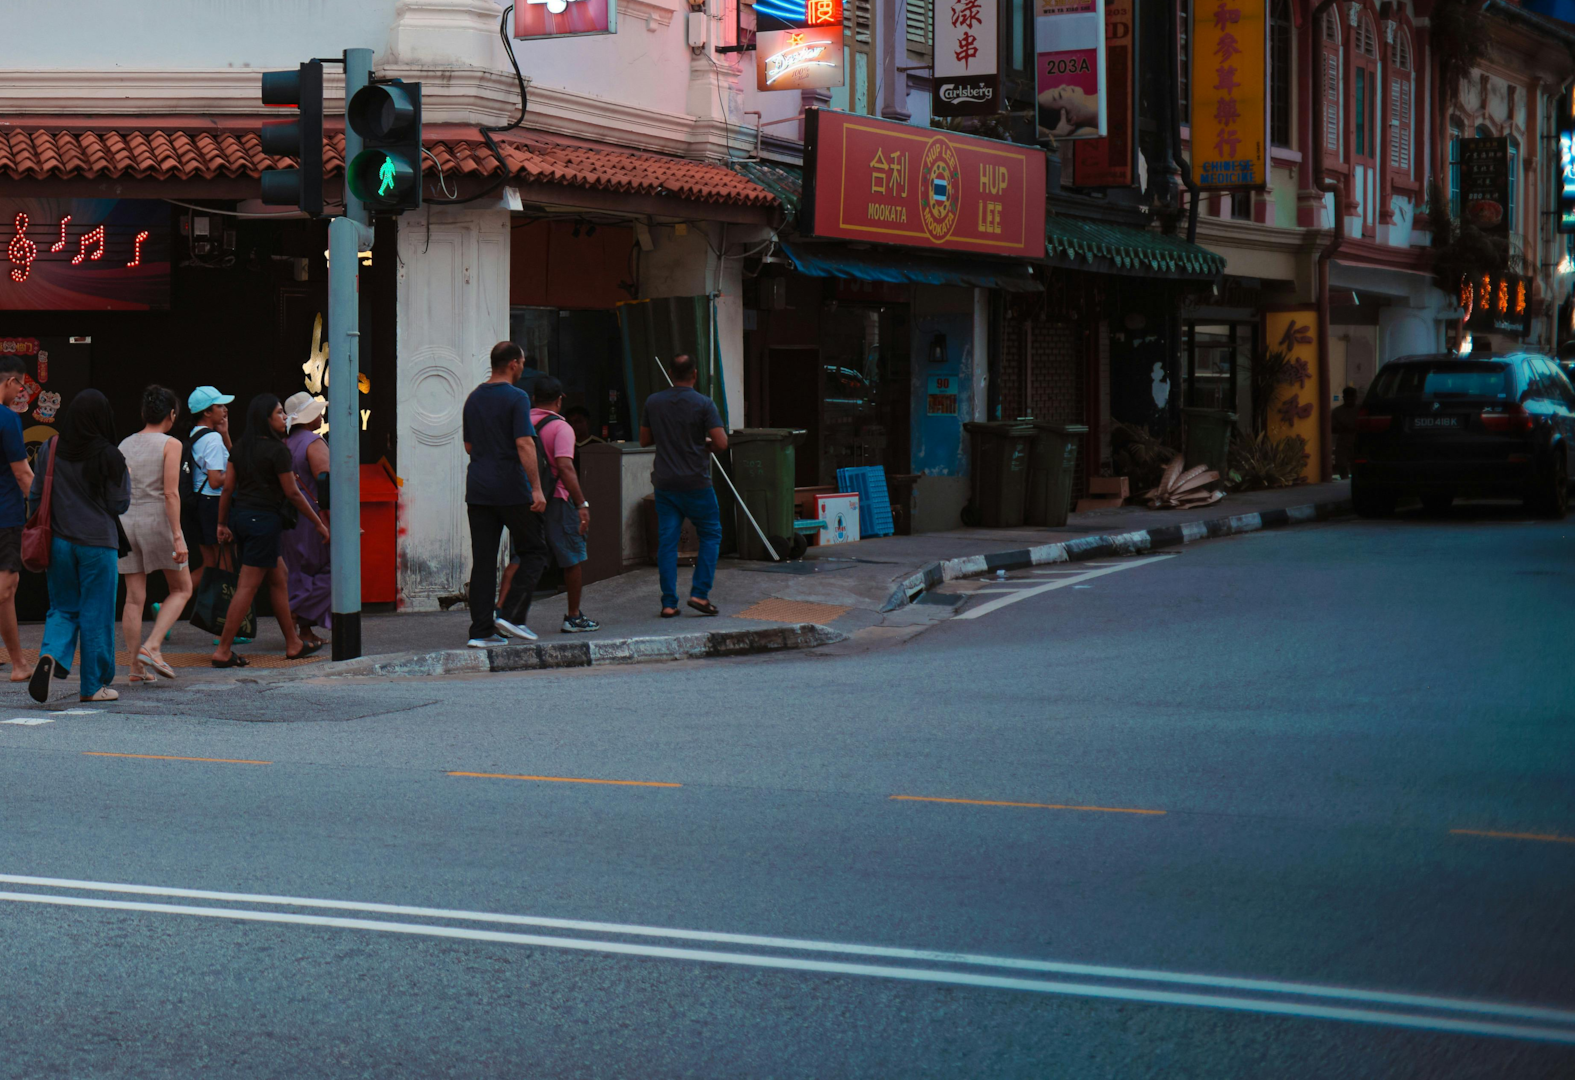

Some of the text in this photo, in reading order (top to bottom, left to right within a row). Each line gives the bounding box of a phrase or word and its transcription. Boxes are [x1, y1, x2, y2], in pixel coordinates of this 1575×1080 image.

[1047, 57, 1091, 76] 203A
[939, 82, 993, 104] Carlsberg
[925, 144, 956, 171] HUP LEE
[1202, 160, 1254, 173] CHINESE
[869, 147, 909, 198] 合利
[979, 163, 1008, 195] HUP
[1199, 172, 1257, 185] MEDICINE
[867, 202, 907, 223] MOOKATA
[923, 207, 955, 237] MOOKATA
[977, 200, 1003, 234] LEE
[937, 378, 950, 389] 90
